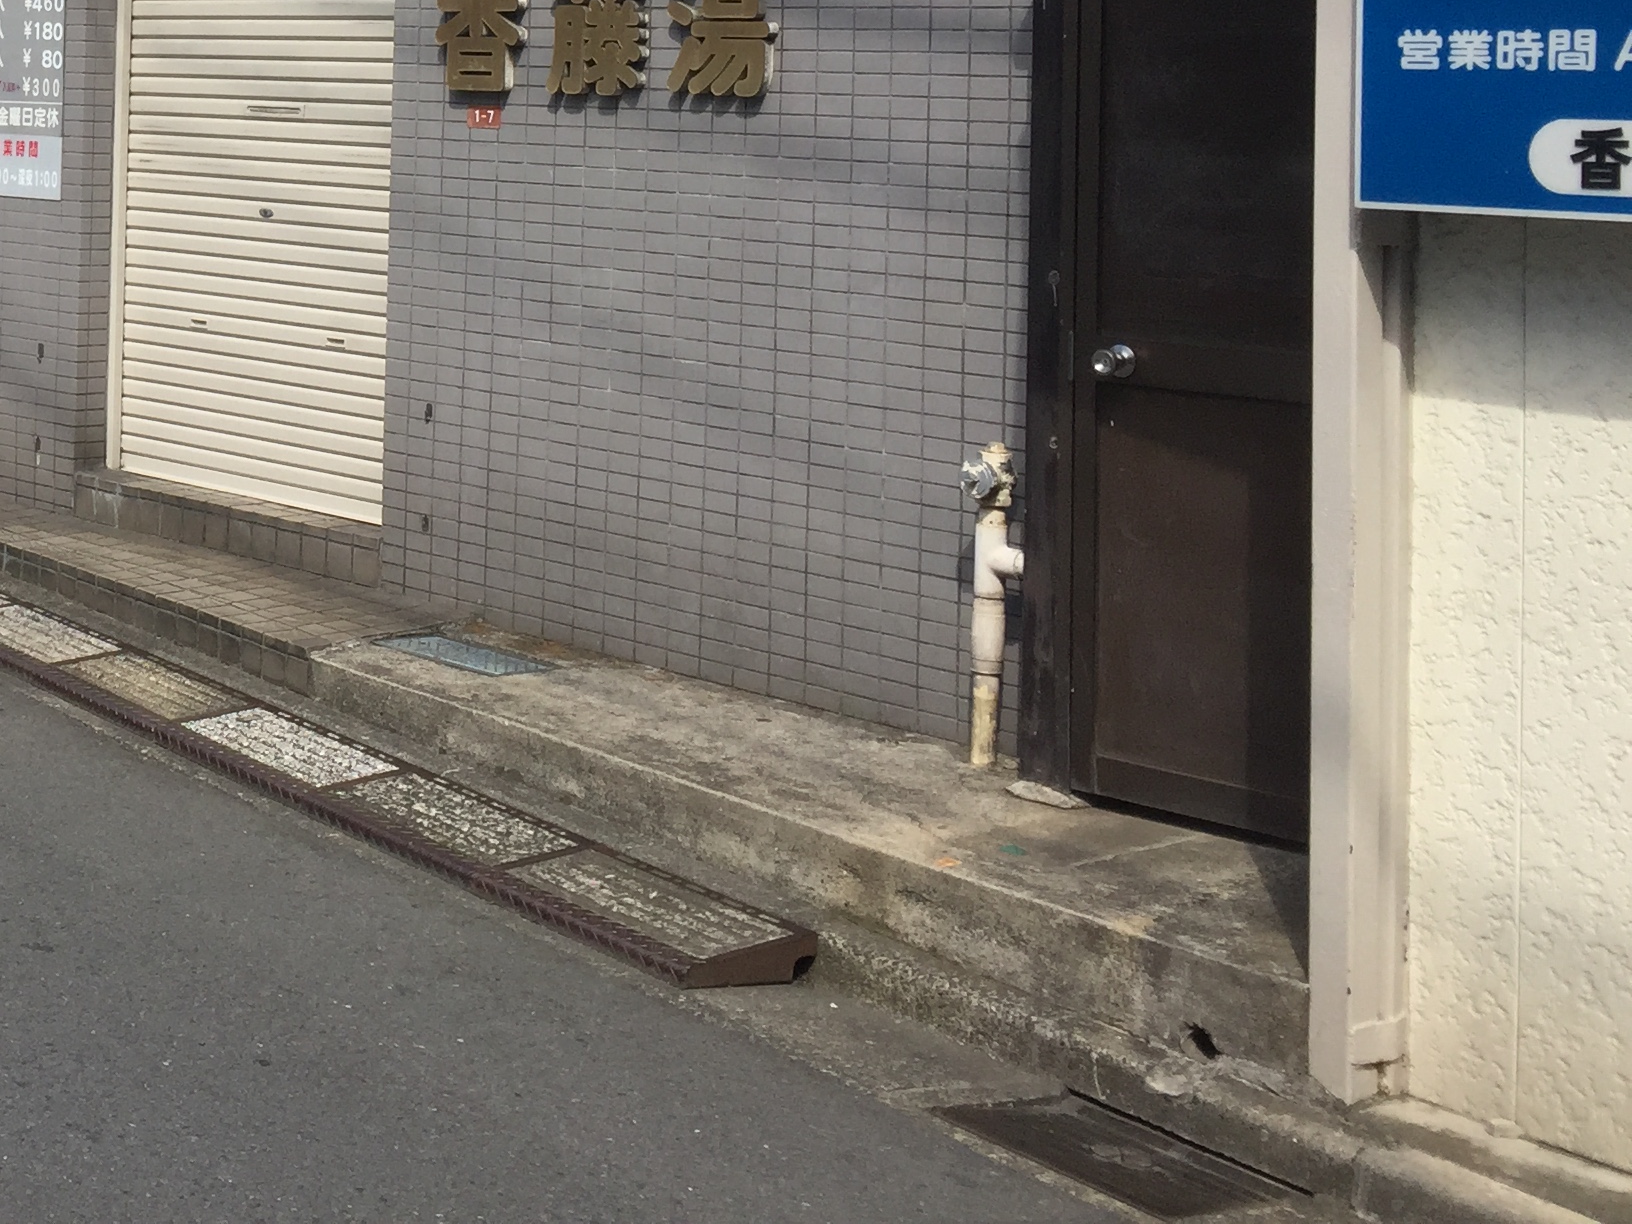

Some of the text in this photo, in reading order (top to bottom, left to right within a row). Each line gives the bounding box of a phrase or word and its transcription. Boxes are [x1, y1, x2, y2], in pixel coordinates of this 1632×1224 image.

[23, 20, 63, 41] ¥180
[1397, 28, 1597, 73] 営業時間
[22, 76, 60, 97] ¥300
[474, 109, 495, 124] 1-7
[1570, 127, 1631, 192] 香
